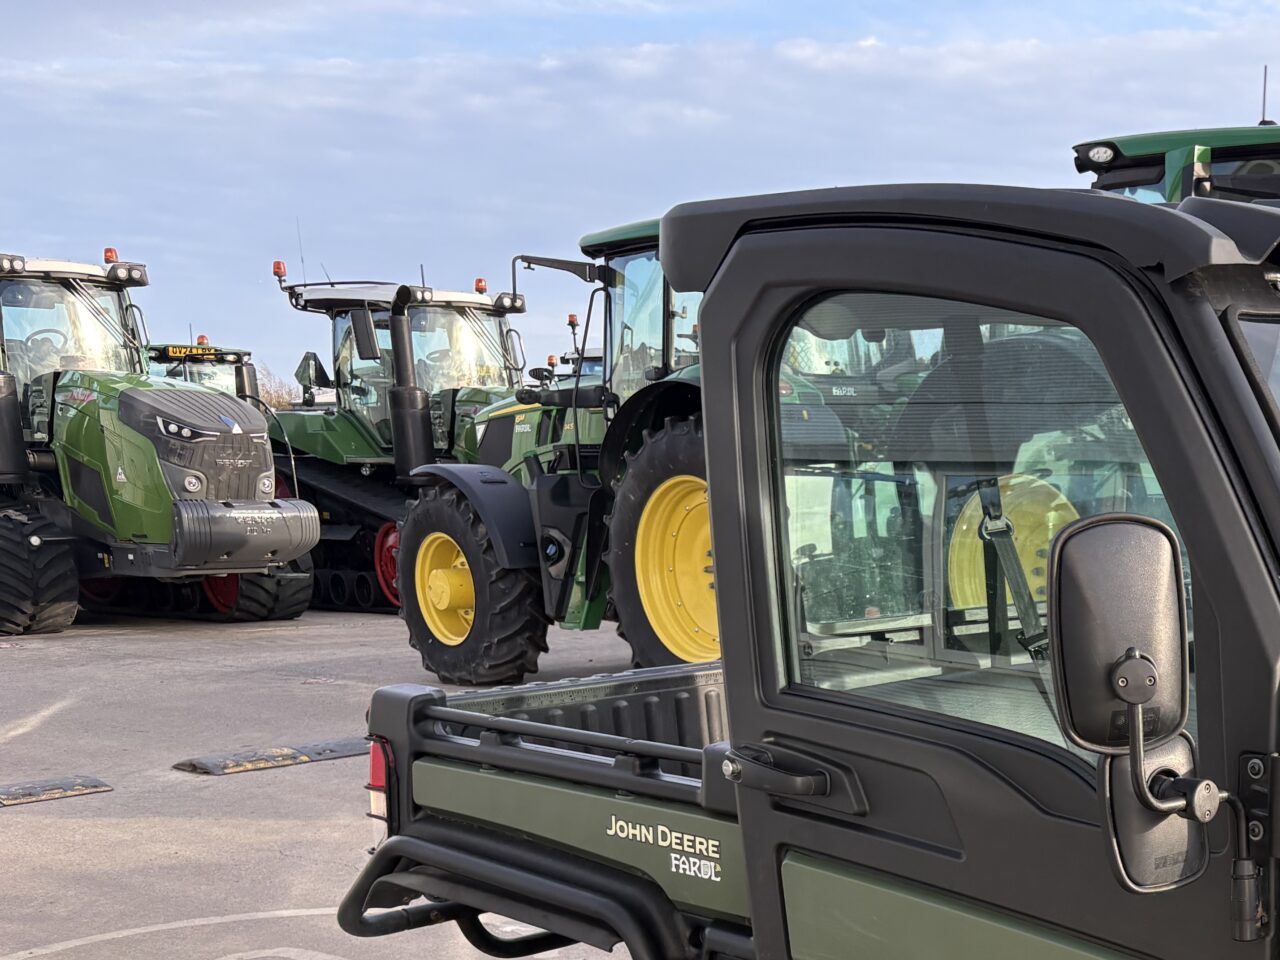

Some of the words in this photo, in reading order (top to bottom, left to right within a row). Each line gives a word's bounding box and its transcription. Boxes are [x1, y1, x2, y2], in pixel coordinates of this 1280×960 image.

[606, 814, 654, 845] JOHN
[657, 824, 720, 858] DEERE
[670, 853, 721, 882] FAROL
